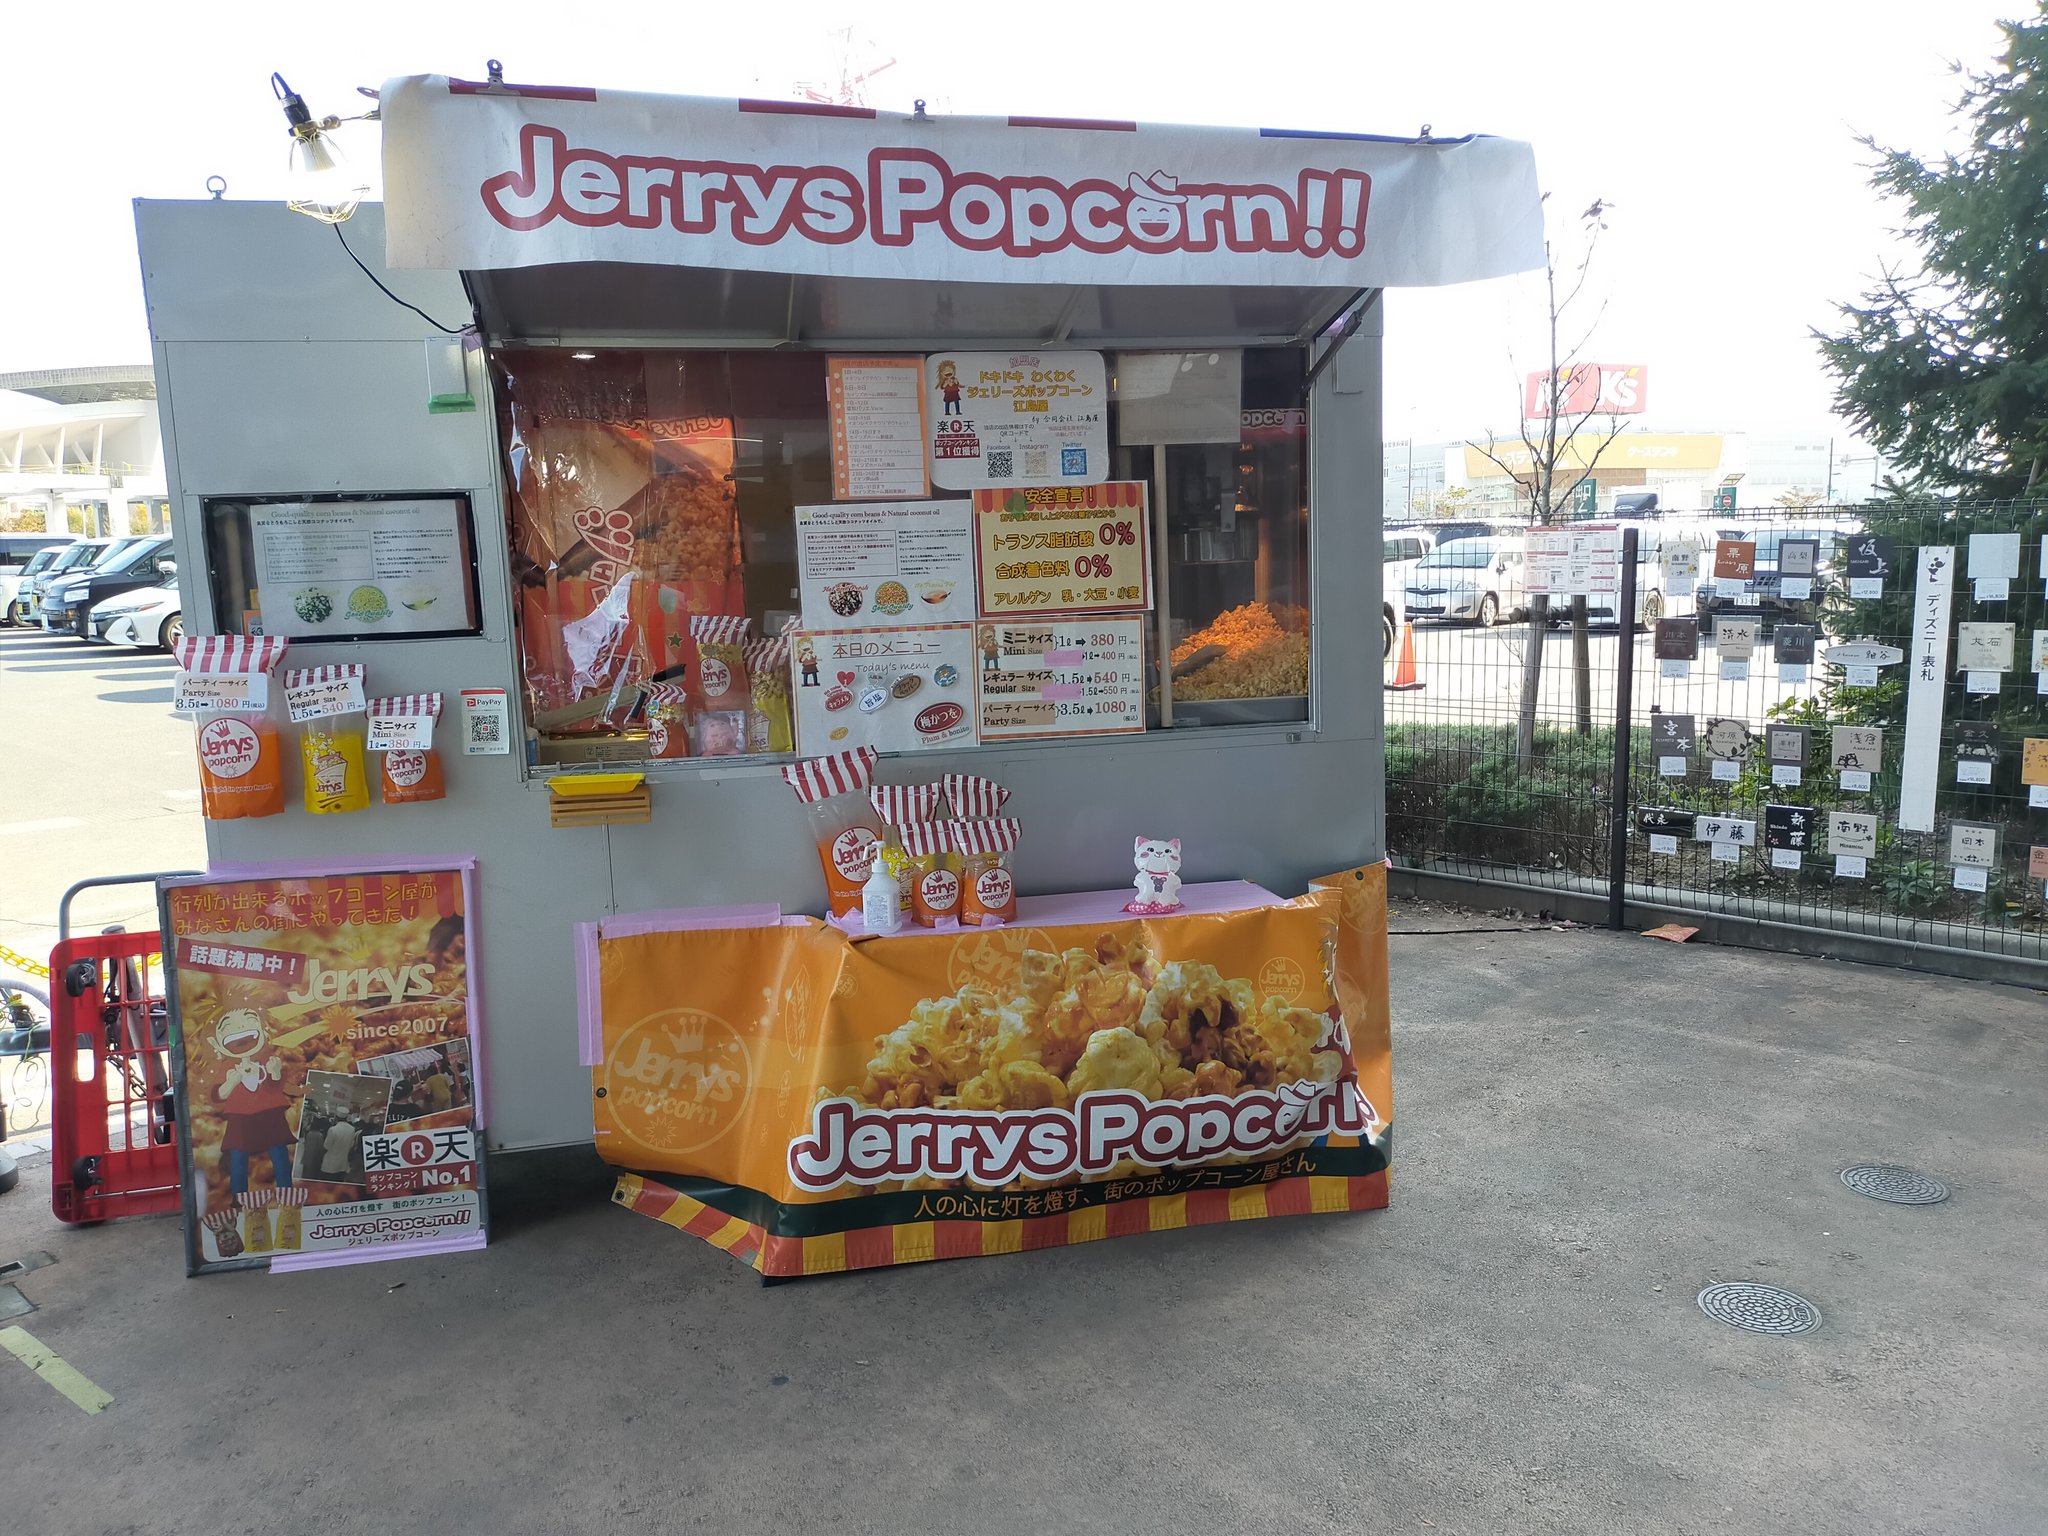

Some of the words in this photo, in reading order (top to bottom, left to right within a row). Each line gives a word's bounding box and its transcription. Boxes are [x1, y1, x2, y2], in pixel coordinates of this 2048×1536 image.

[483, 124, 866, 246] Jerrys
[979, 371, 1024, 383] ドキドキ
[1031, 370, 1076, 383] わくわく
[967, 384, 1093, 399] ジェリーズポップコーン
[1019, 443, 1049, 451] Instagram
[1025, 487, 1094, 504] 安全宣言！
[812, 510, 850, 520] Good-quality
[887, 509, 909, 517] Natural
[993, 531, 1094, 550] トランス脂肪酸
[1099, 521, 1136, 545] 0%
[995, 560, 1069, 579] 合成着色料
[1075, 554, 1112, 578] 0%
[994, 591, 1051, 605] アレルゲン
[1003, 632, 1054, 644] ミニサイズ
[1091, 633, 1115, 646] 380
[1118, 635, 1127, 645] 円
[1921, 594, 1941, 681] ディズニー表札
[832, 641, 941, 658] 本日のメニュー
[1003, 646, 1026, 655] Mini
[1027, 647, 1043, 655] Size
[1101, 651, 1116, 660] 400
[1118, 652, 1125, 660] 円
[855, 662, 897, 675] Today's
[900, 662, 930, 671] menu
[183, 679, 248, 687] パーティーサイズ
[983, 673, 1025, 683] レギュラー
[1027, 670, 1053, 680] サイズ
[1094, 671, 1118, 683] 540
[1121, 672, 1130, 682] 円
[182, 689, 206, 697] Party
[287, 689, 323, 701] レギュラー
[326, 683, 349, 693] サイズ
[983, 684, 1017, 694] Regular
[1021, 684, 1036, 692] Size
[1103, 686, 1118, 695] 550
[1120, 687, 1128, 695] 円
[210, 698, 239, 708] 1080
[290, 698, 320, 710] Regular
[321, 703, 344, 714] 540
[347, 702, 356, 710] 円
[477, 698, 502, 706] PayPay
[983, 702, 1056, 713] パーティーサイズ
[1095, 700, 1127, 714] 1080
[1129, 704, 1137, 712] 円
[919, 706, 958, 729] 梅かつを
[983, 717, 1010, 726] Party
[1011, 717, 1026, 725] Size
[373, 720, 417, 730] ミニサイズ
[921, 734, 941, 744] Plum
[948, 726, 970, 736] bonito
[1663, 719, 1692, 752] 宮本
[202, 736, 254, 757] Jerrys
[388, 739, 409, 748] 380
[413, 740, 420, 748] 円
[208, 753, 251, 768] popcorn
[387, 755, 423, 771] Jerrys
[391, 768, 422, 779] popcorn
[314, 780, 342, 793] Jerrys
[1706, 823, 1745, 840] 伊藤
[1790, 812, 1806, 847] 新藤
[1838, 821, 1868, 833] 南野
[922, 878, 957, 896] Jerrys
[977, 879, 1010, 895] Jerrys
[927, 892, 955, 903] popcorn
[982, 892, 1009, 902] popcorn
[189, 945, 298, 976] 話題沸騰中！
[287, 959, 436, 1005] Jerrys
[1262, 970, 1301, 986] Jerrys
[1265, 985, 1297, 994] popcorn
[614, 1038, 741, 1103] Jerrys
[617, 1085, 718, 1127] popcorn
[789, 1098, 1078, 1190] Jerrys
[370, 1172, 418, 1183] ポップコーン
[371, 1180, 417, 1192] ランキング！
[914, 1185, 1091, 1220] 人の心に灯を燈す、
[1104, 1154, 1318, 1200] 街のポップコーン屋さん
[316, 1203, 384, 1216] 人の心に灯を燈す
[392, 1193, 467, 1209] 街のポップコーン！
[310, 1221, 375, 1241] Jerrys
[348, 1229, 440, 1246] ジェリーズポップコーン
